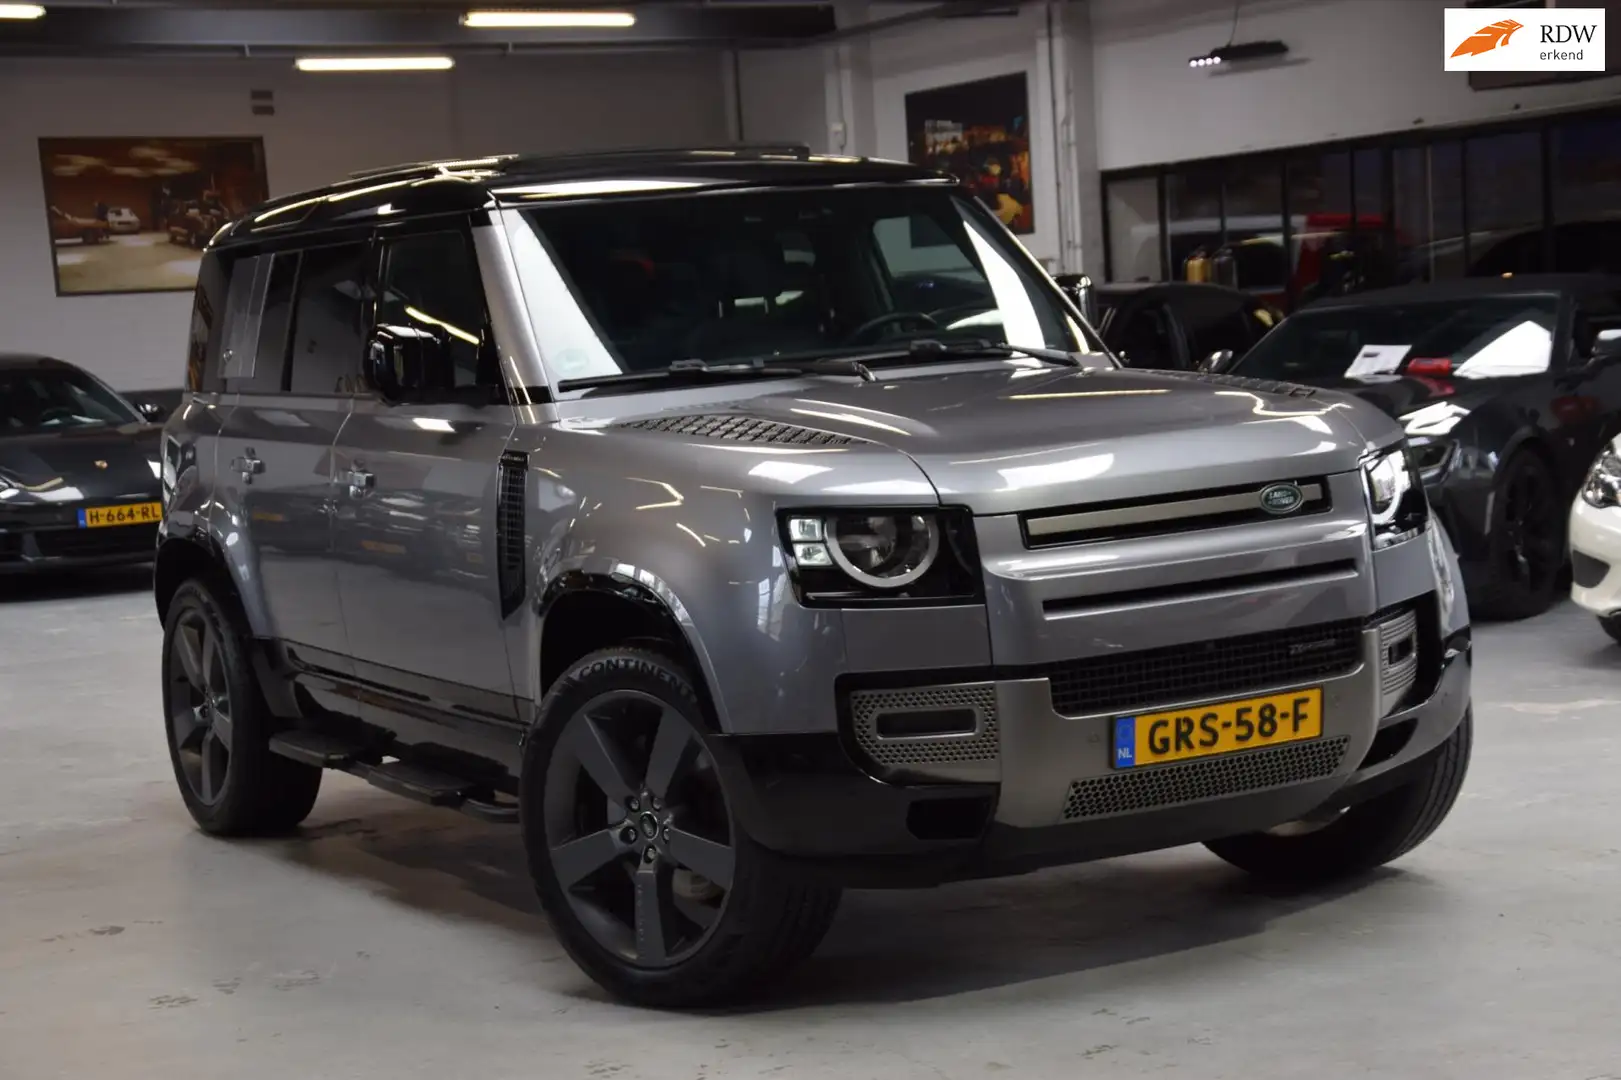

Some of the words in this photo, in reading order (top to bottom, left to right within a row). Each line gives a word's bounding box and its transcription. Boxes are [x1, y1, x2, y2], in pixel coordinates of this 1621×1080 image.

[89, 505, 160, 525] H-664-RL
[1148, 697, 1310, 755] GRS-58-F
[1118, 747, 1133, 760] NL
